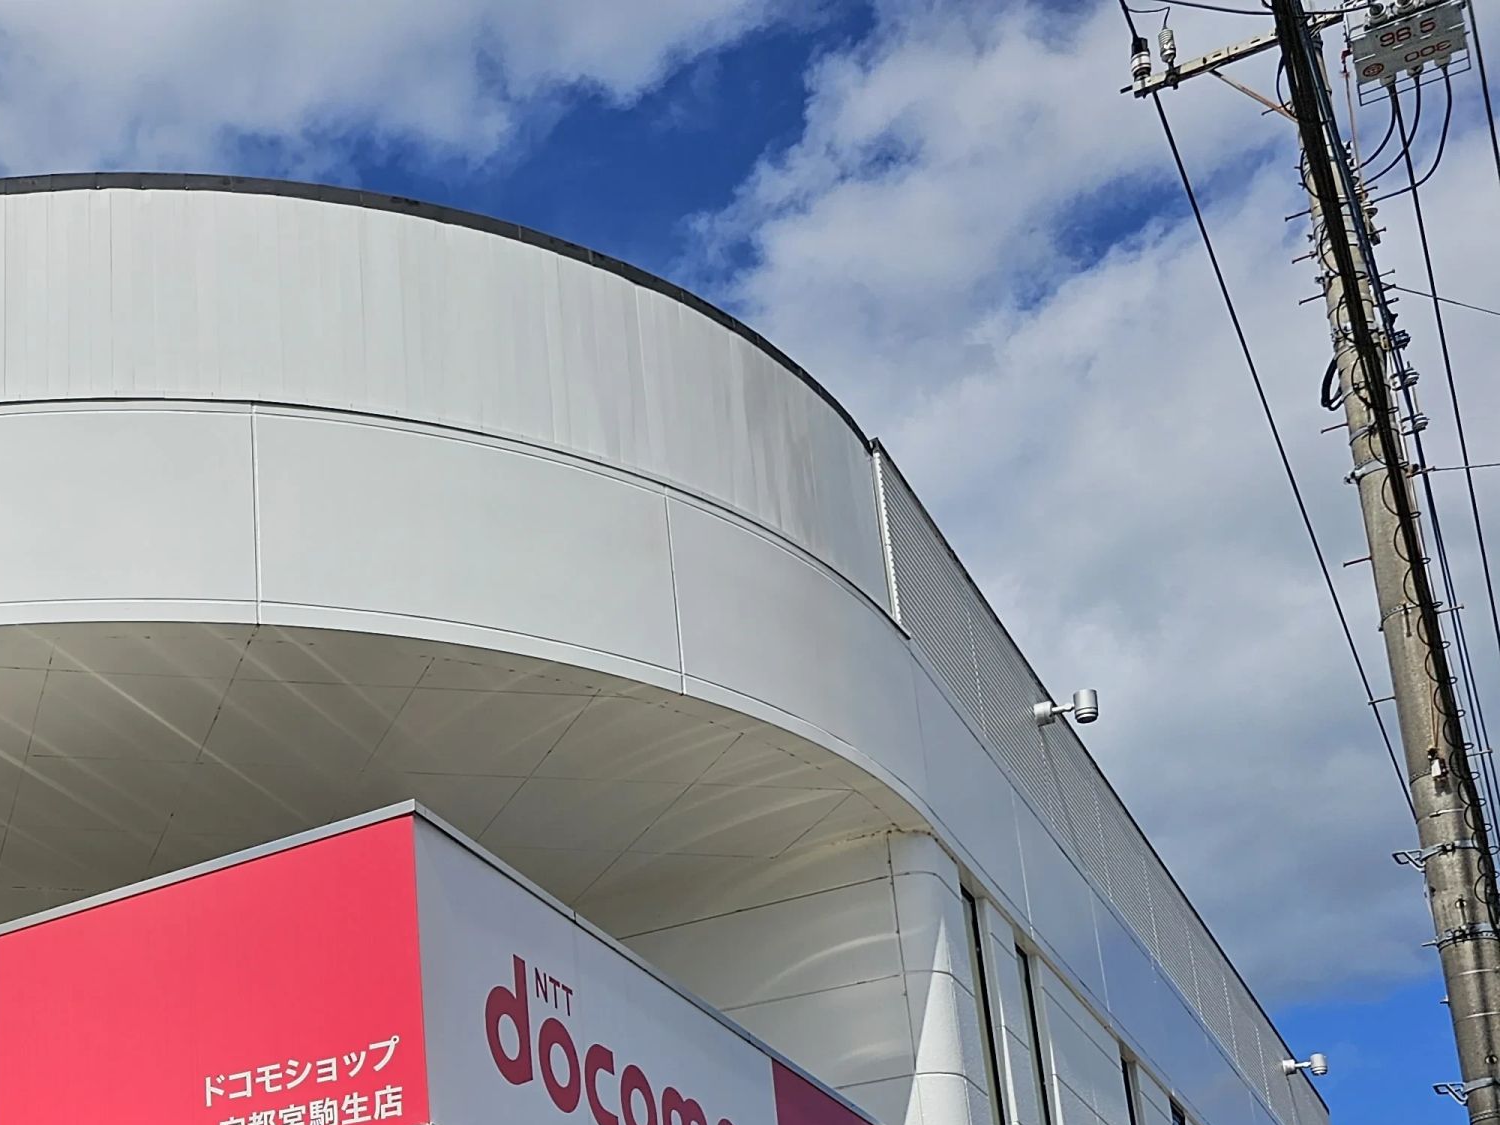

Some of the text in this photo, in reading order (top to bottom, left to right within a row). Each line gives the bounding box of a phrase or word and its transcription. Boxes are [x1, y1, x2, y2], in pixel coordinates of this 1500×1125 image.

[535, 967, 572, 1016] NTT
[204, 1035, 399, 1107] ドコモショップ
